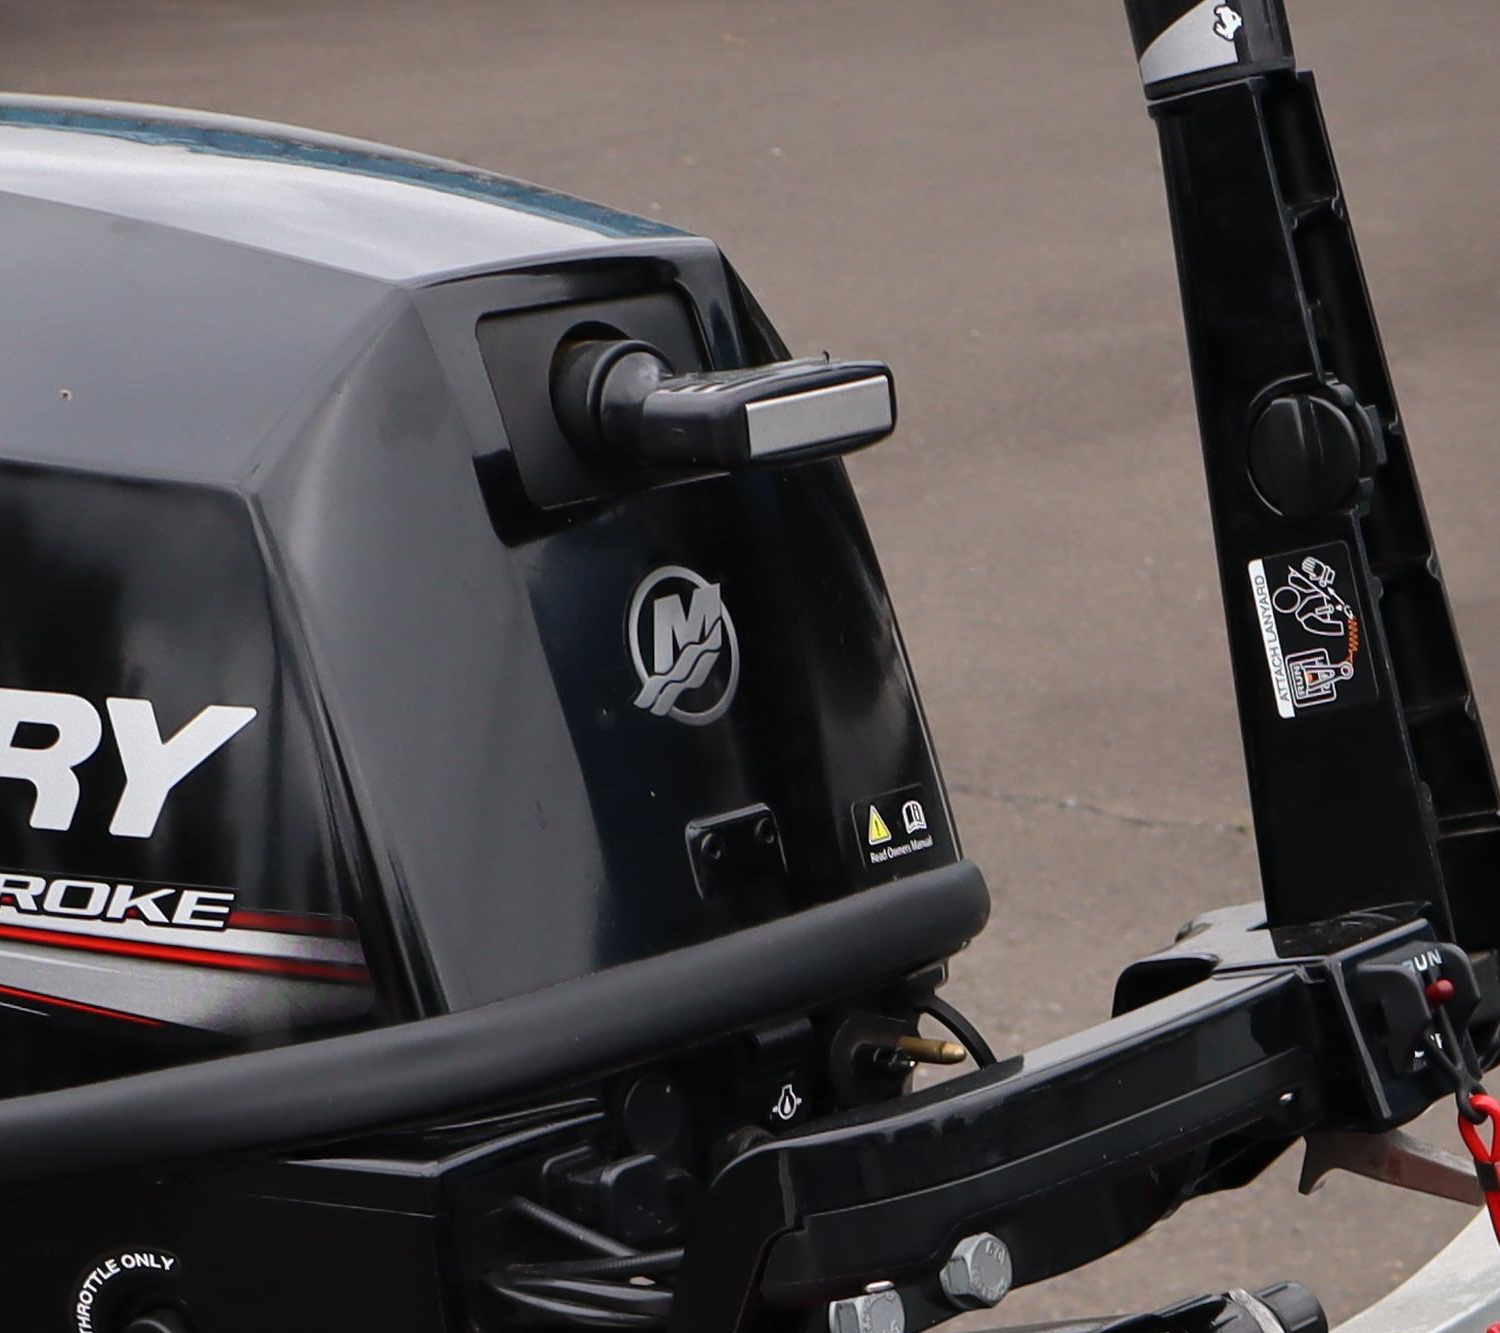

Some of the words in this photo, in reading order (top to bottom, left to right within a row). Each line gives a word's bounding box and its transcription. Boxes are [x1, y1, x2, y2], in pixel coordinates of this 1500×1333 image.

[1254, 575, 1277, 642] LANYARD
[1270, 647, 1290, 702] ATTACH
[120, 1252, 175, 1271] ONLY
